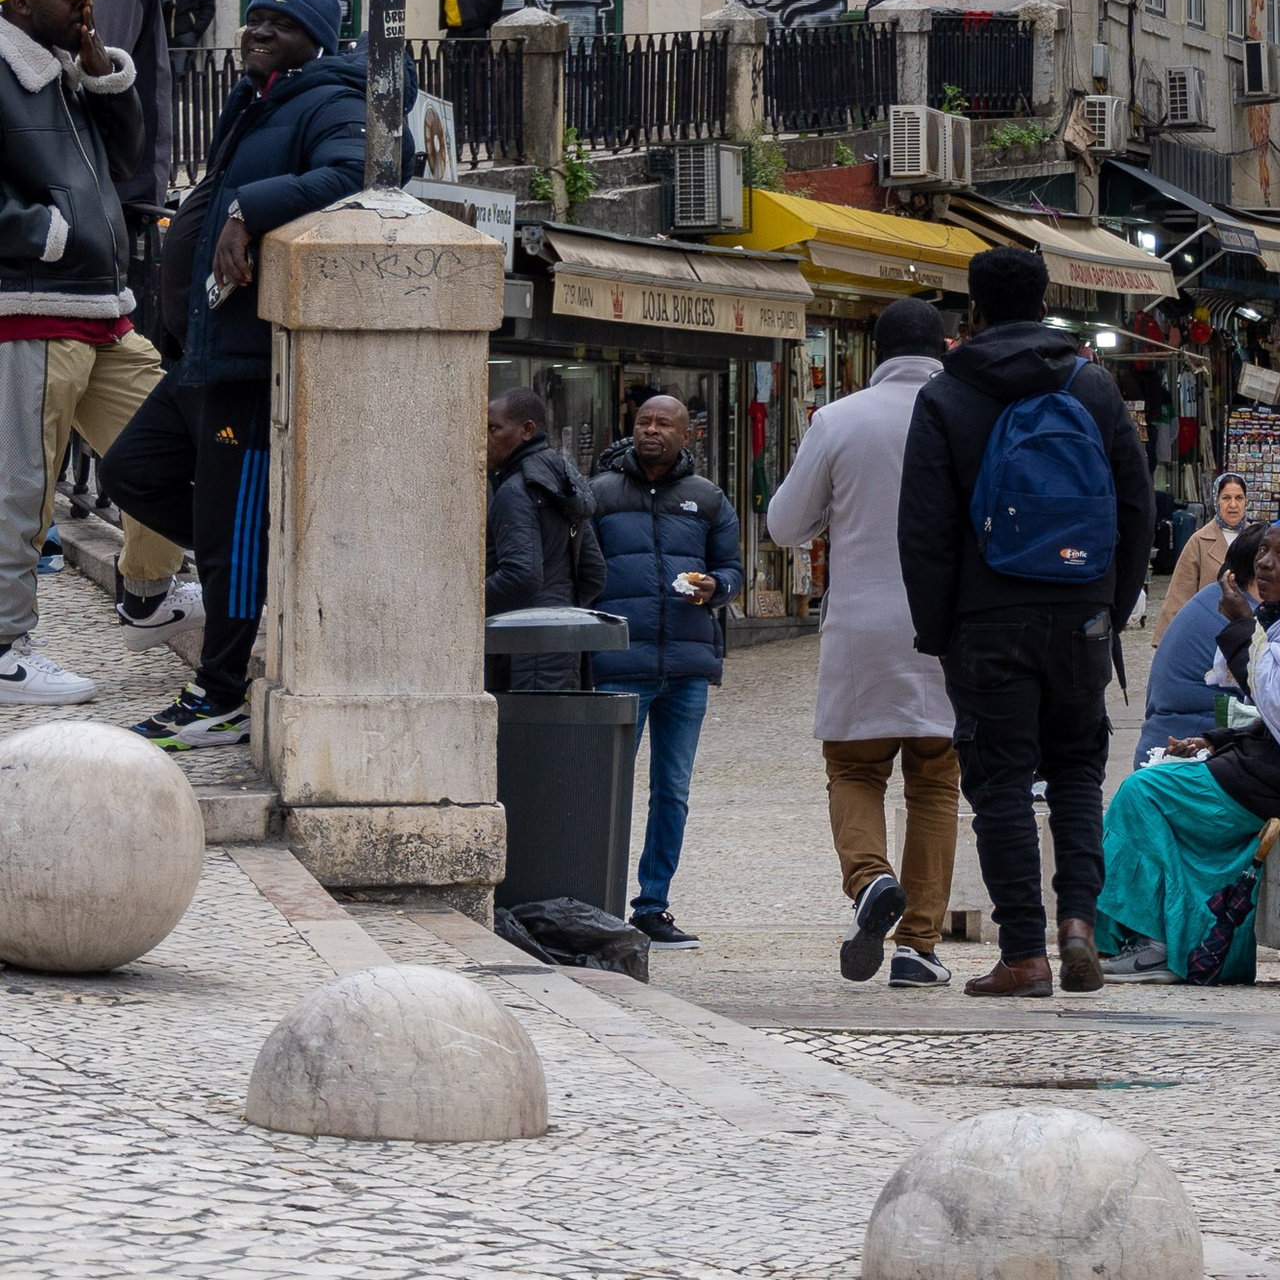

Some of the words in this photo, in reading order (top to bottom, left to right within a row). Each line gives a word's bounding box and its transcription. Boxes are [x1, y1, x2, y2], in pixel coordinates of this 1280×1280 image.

[493, 203, 511, 225] Venda
[643, 291, 668, 322] LOJA
[673, 294, 715, 327] BORGES
